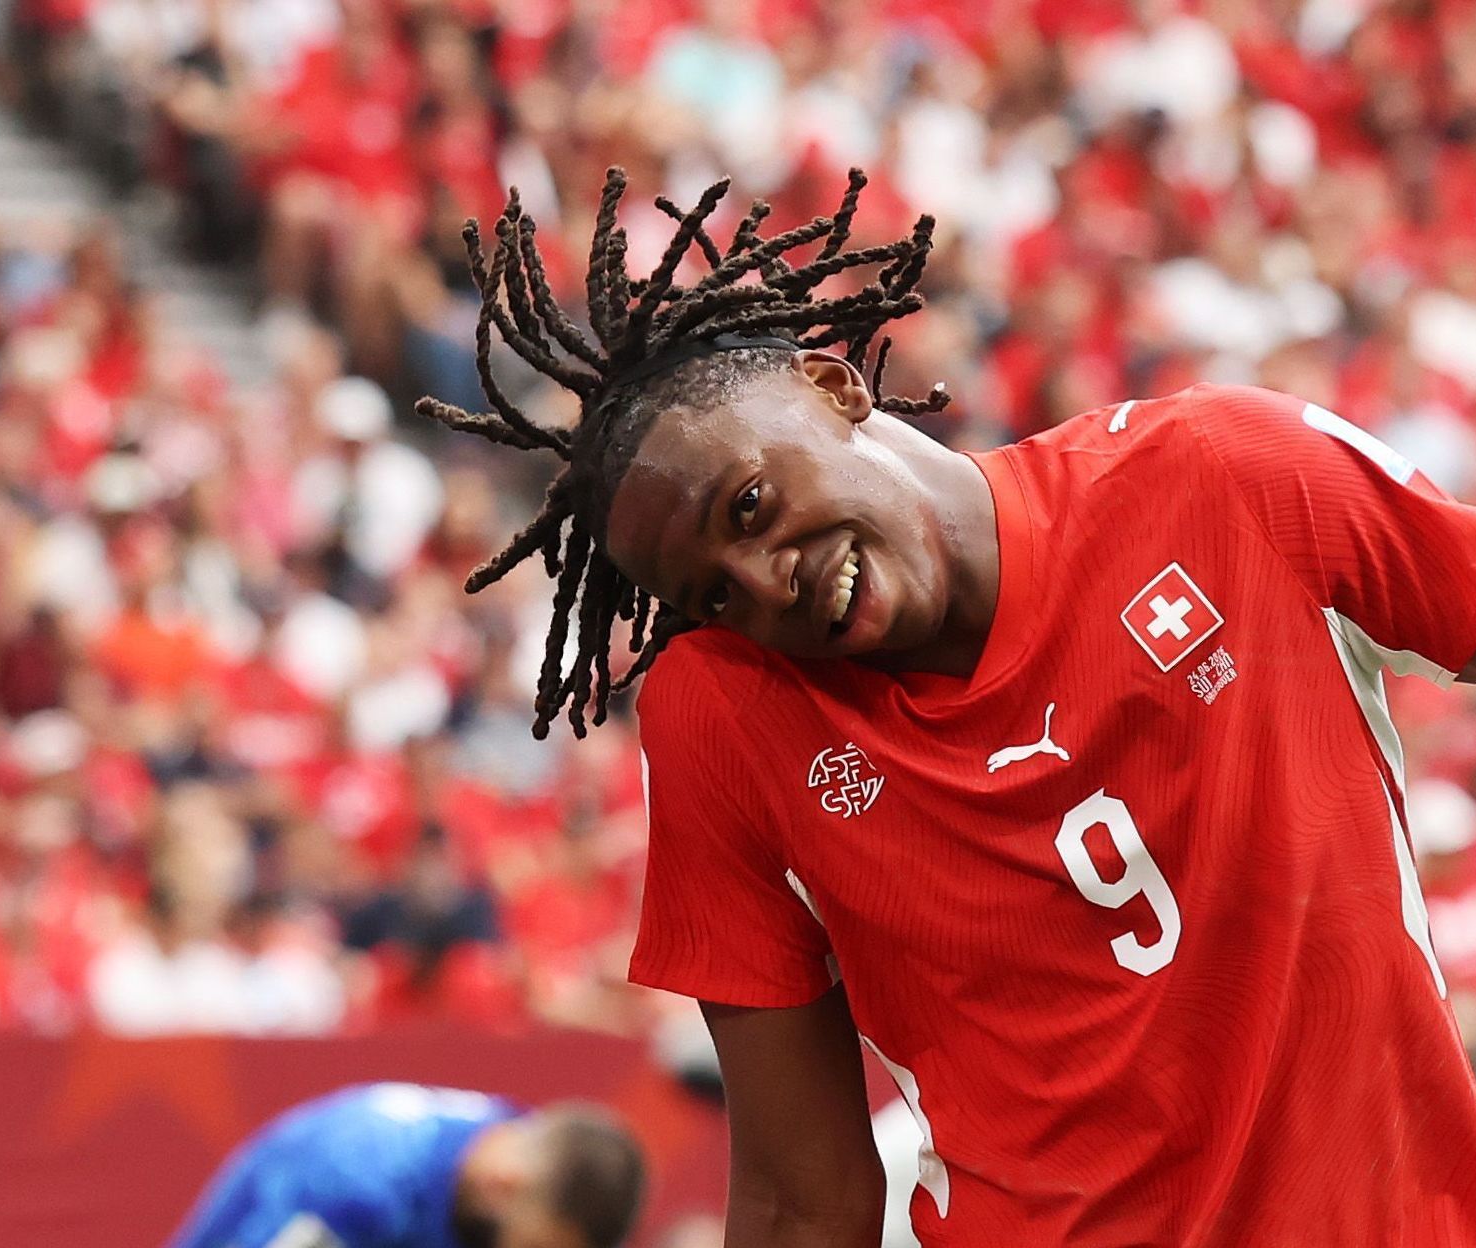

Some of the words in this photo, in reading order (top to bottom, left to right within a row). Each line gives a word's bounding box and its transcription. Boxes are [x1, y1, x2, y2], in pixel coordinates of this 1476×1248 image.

[1191, 675, 1213, 698] SUI
[1215, 652, 1235, 677] CAN
[1054, 787, 1182, 977] 9
